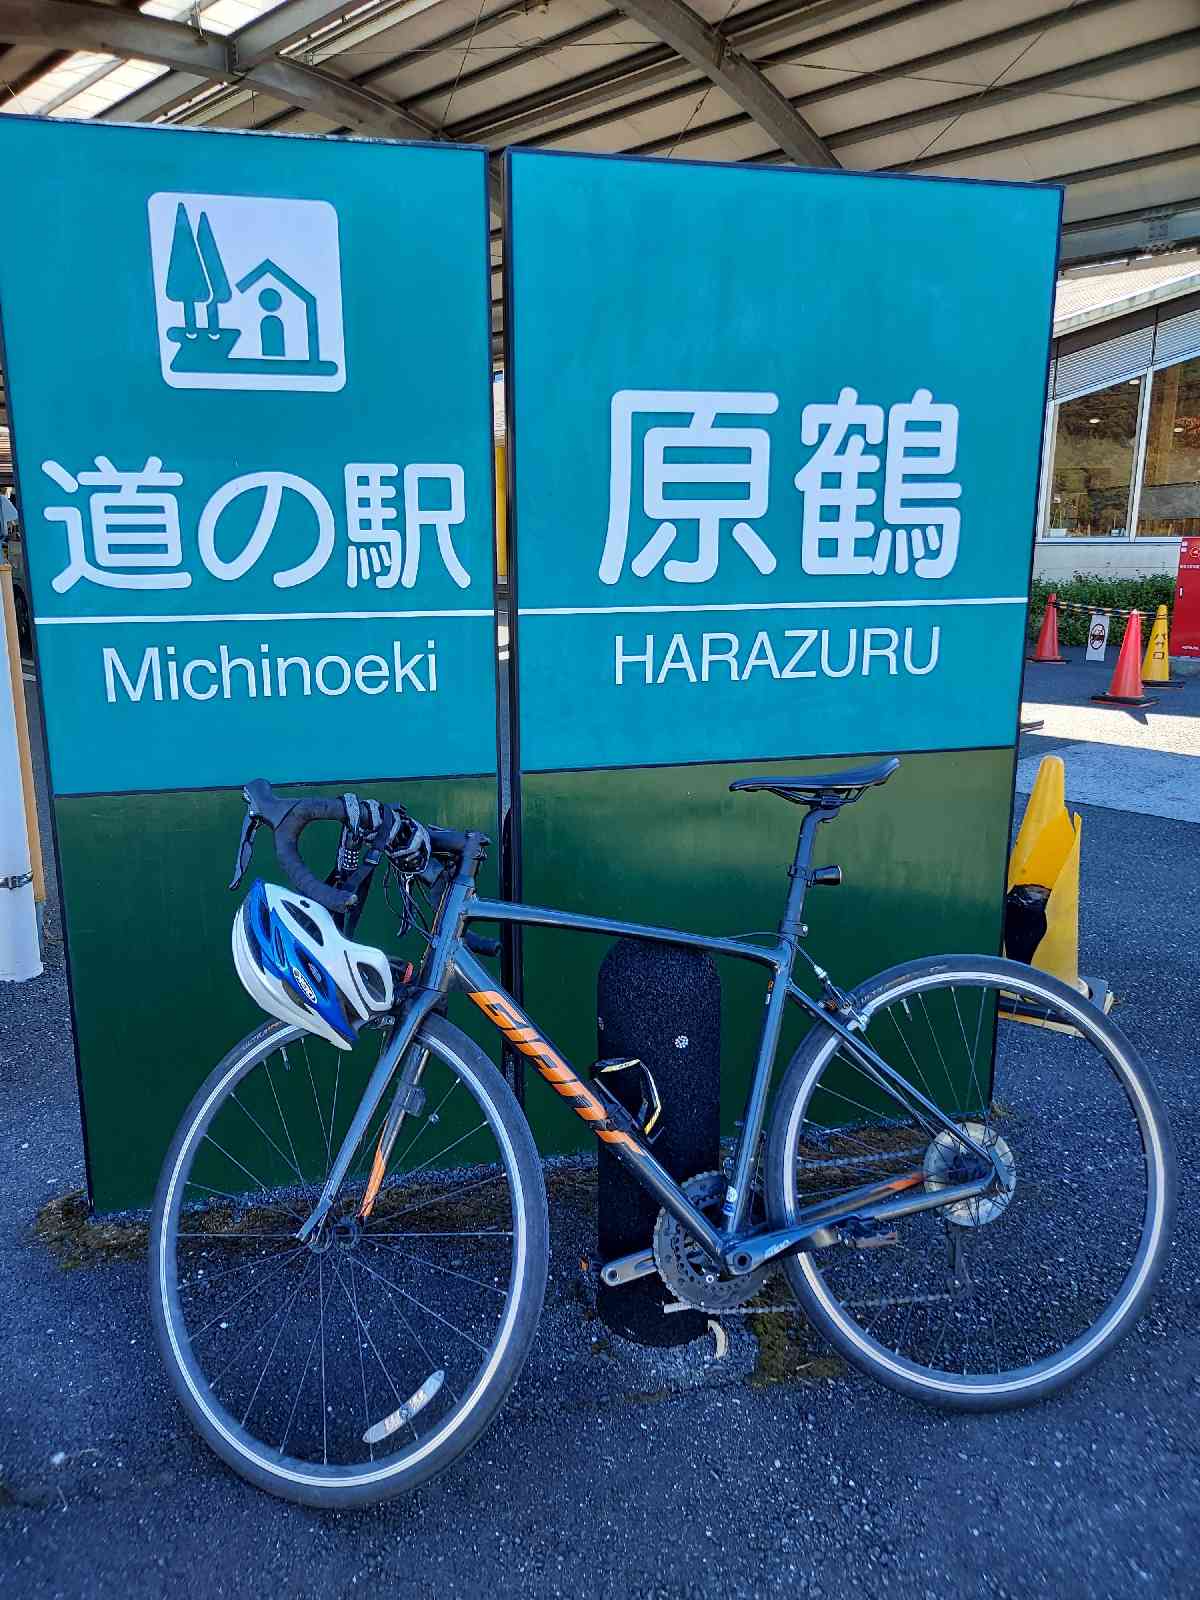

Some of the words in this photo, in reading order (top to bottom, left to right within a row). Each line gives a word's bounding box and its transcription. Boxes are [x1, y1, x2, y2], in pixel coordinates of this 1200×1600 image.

[42, 456, 470, 593] 道の駅
[599, 388, 961, 584] 原鶴
[103, 640, 438, 703] Michinoeki
[614, 627, 940, 685] HARAZURU
